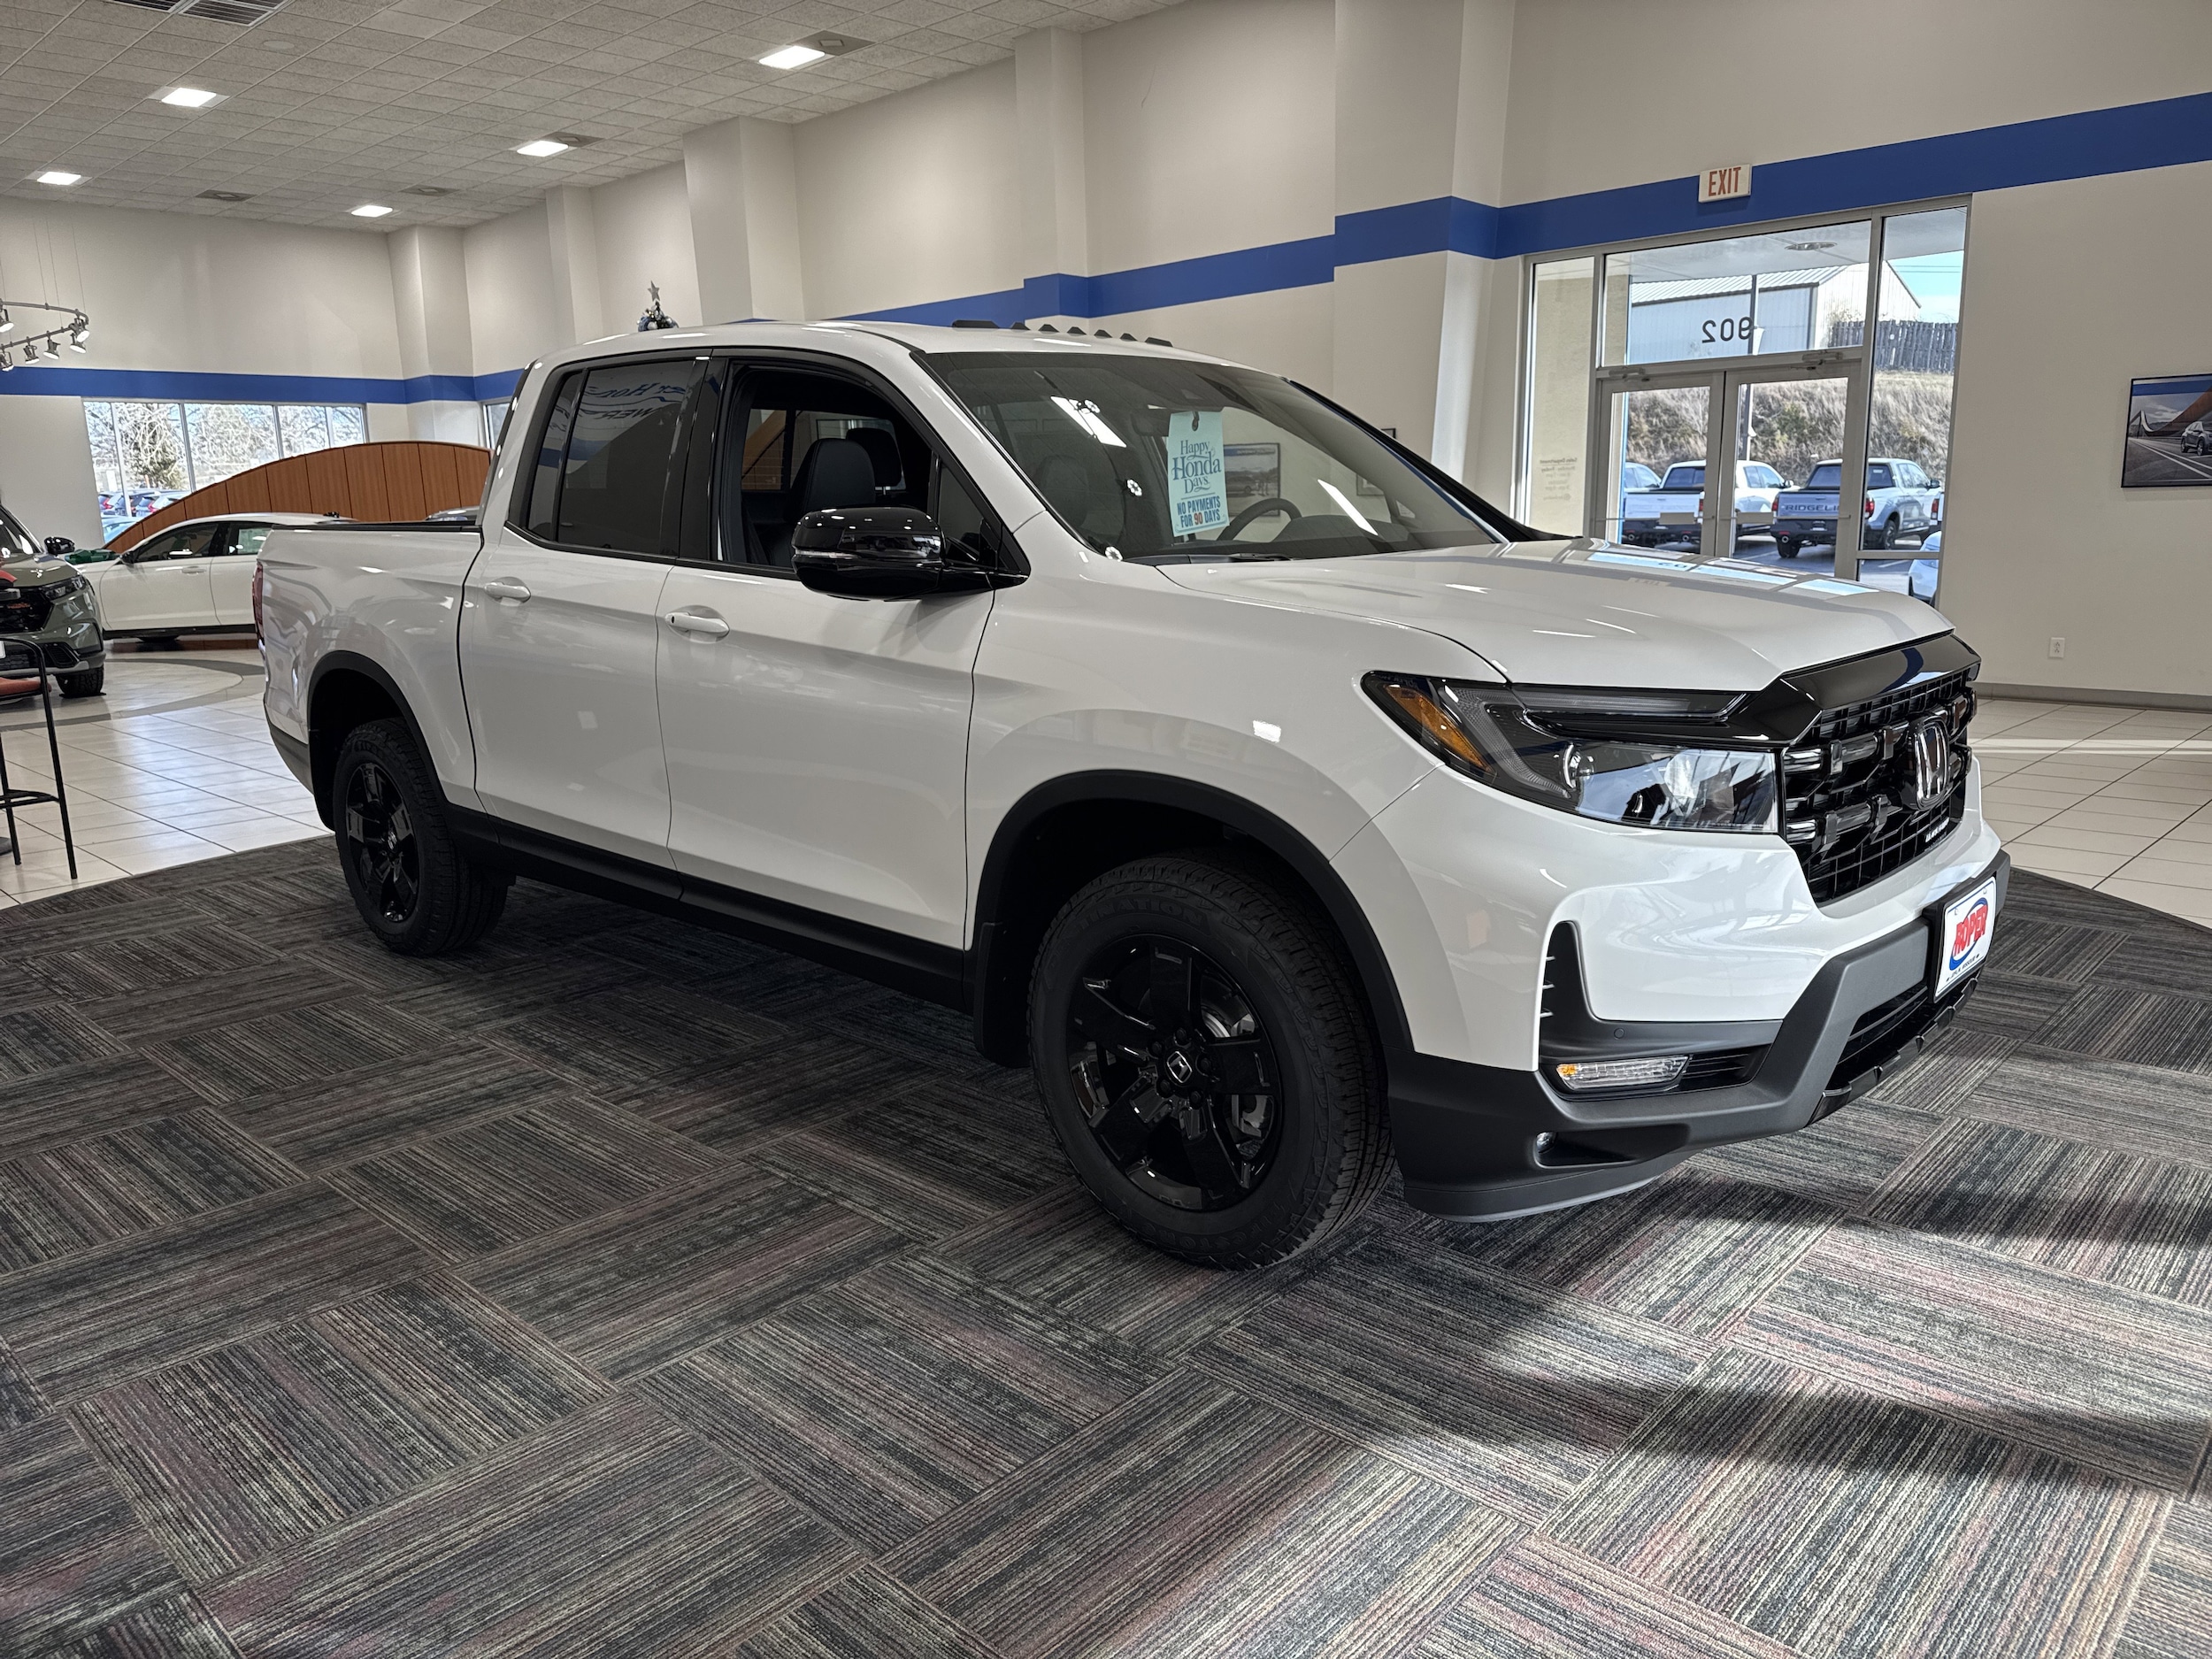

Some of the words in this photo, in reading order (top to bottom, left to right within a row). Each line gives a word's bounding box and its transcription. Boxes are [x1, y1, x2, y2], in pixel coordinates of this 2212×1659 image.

[1708, 166, 1741, 197] EXIT
[1180, 440, 1210, 457] Happy
[1171, 451, 1222, 480] Honda
[1184, 476, 1210, 494] Days
[1177, 502, 1187, 516] NO
[1187, 495, 1221, 513] PAYMENTS
[1180, 513, 1194, 528] FOR
[1194, 511, 1203, 526] 90
[1204, 509, 1221, 524] DAYS
[1954, 904, 1989, 957] ROPER
